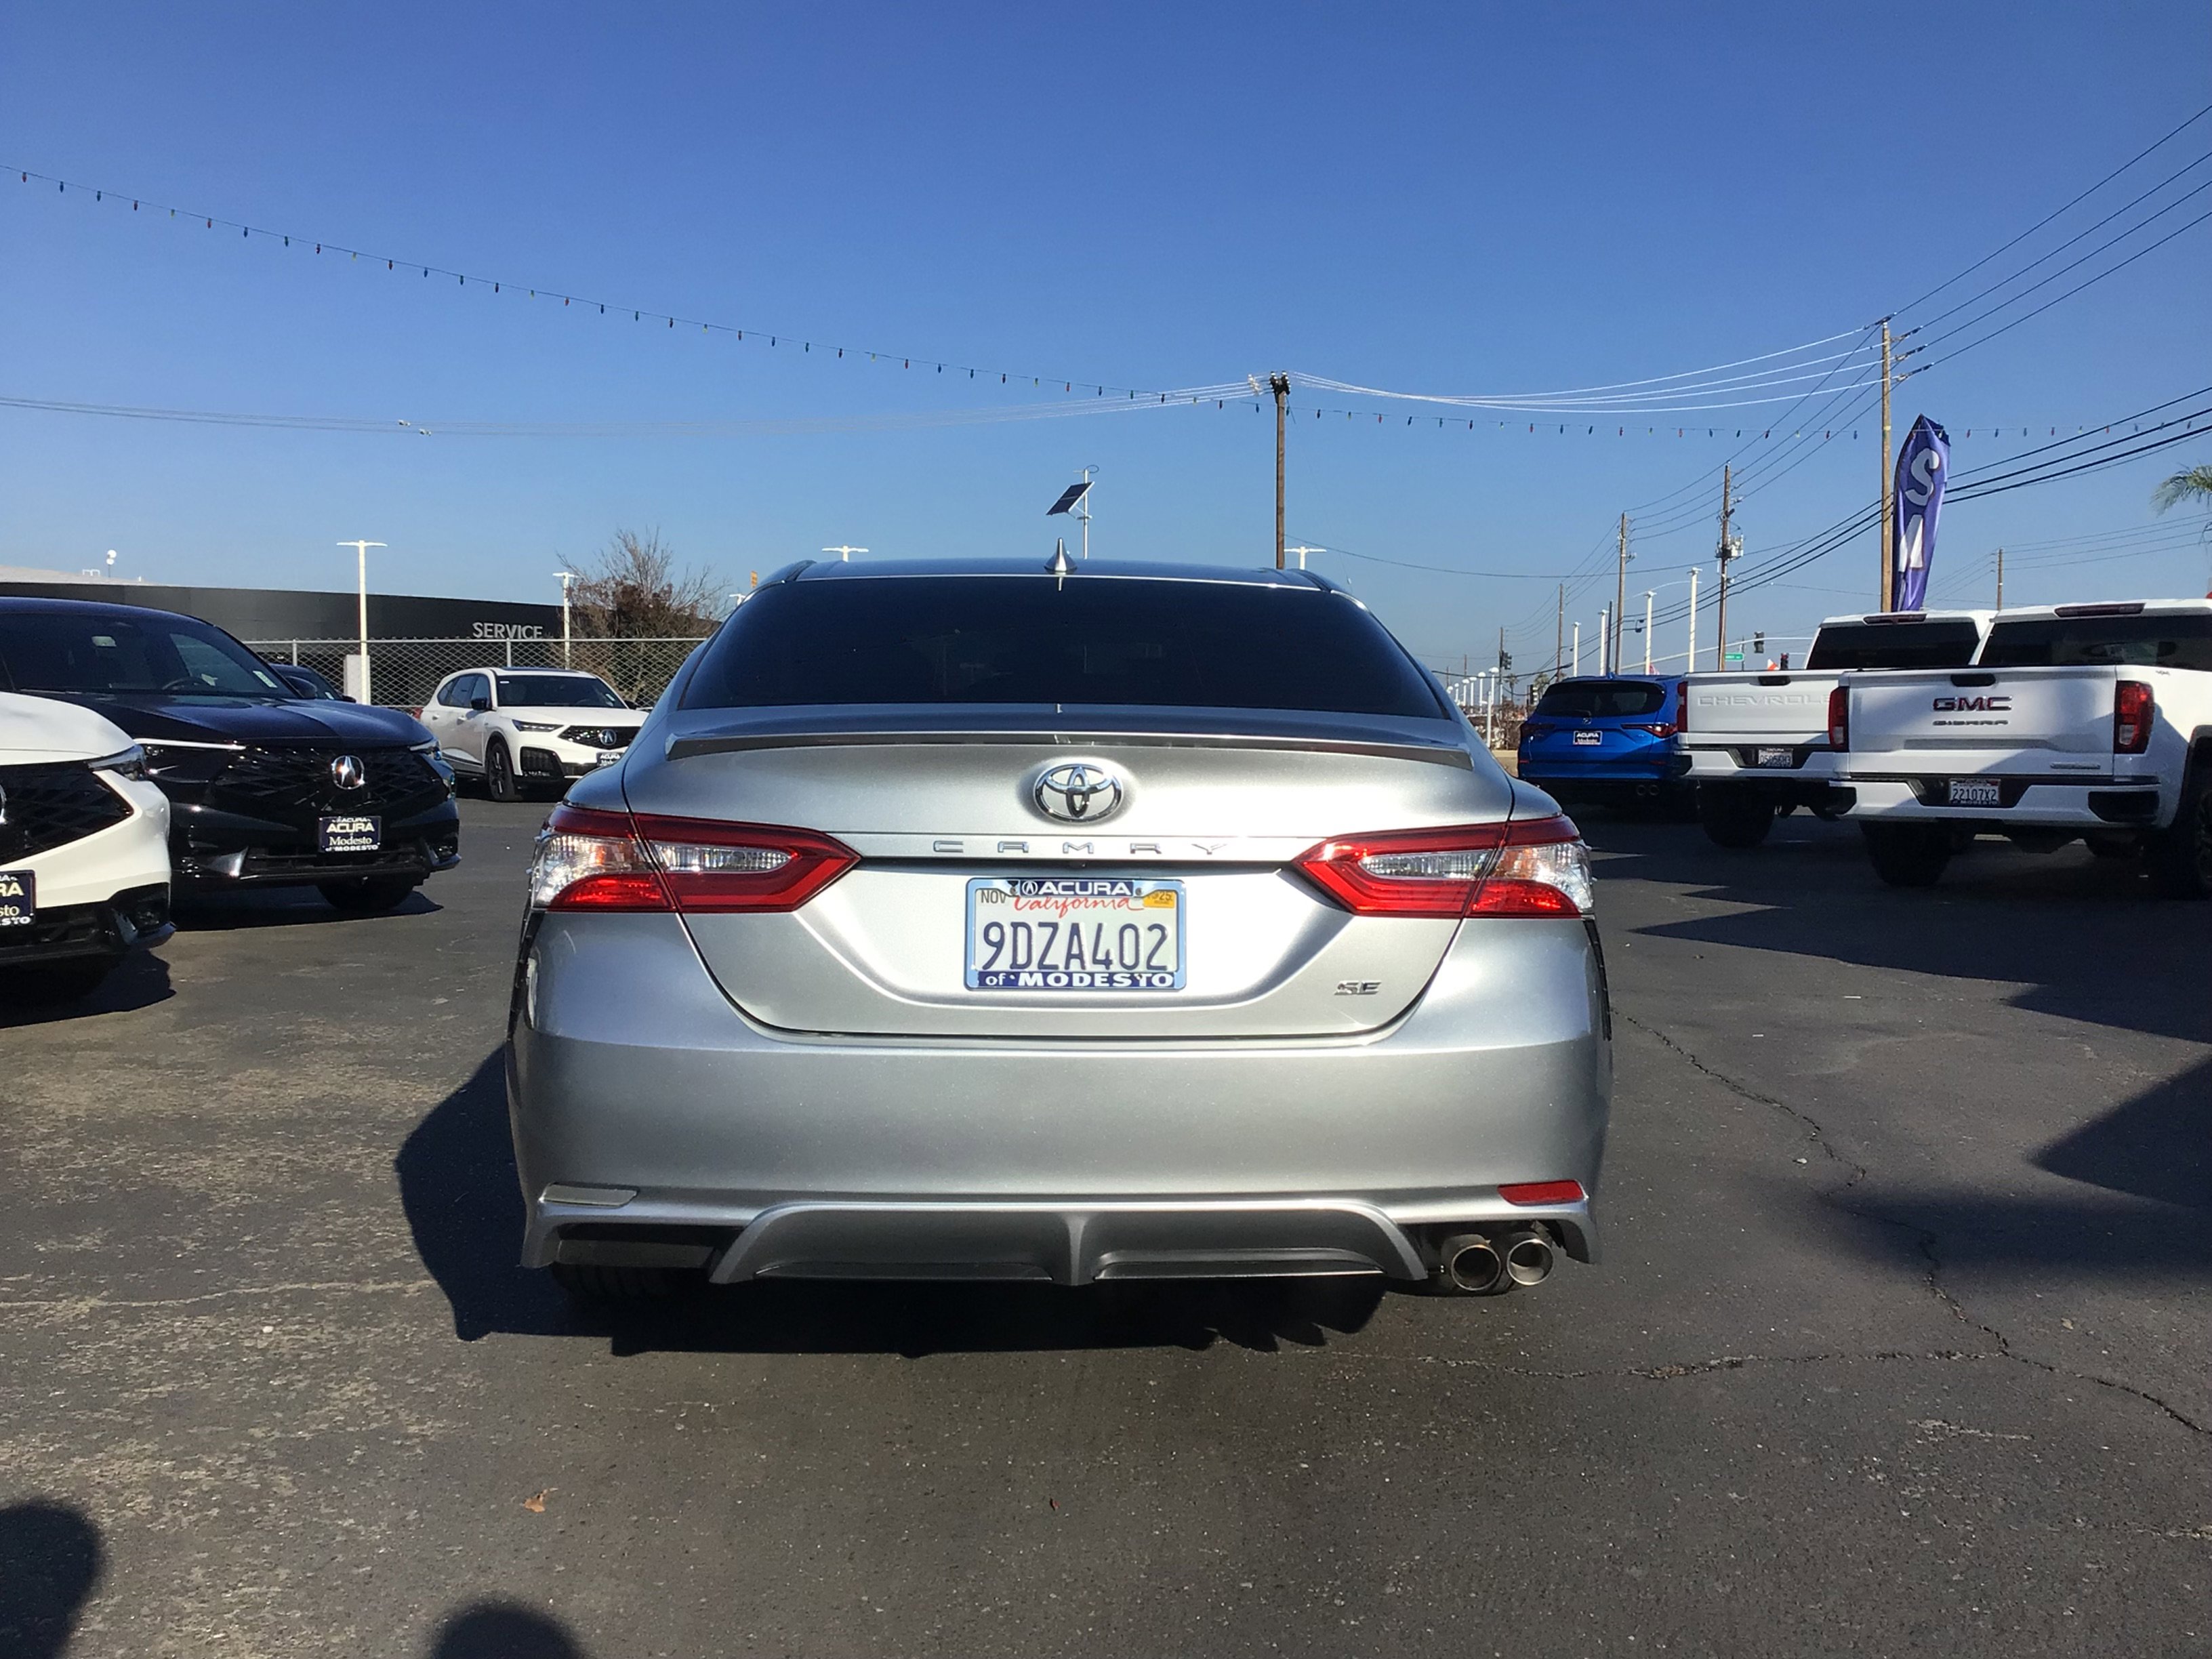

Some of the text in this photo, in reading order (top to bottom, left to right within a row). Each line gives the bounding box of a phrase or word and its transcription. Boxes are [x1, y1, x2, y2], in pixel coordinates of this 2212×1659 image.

[472, 622, 543, 639] SERVICE
[1698, 695, 1830, 706] CHEVROL
[1933, 697, 2011, 711] GMC
[1952, 789, 1996, 801] 22107X2
[326, 822, 375, 833] ACURA
[329, 836, 373, 846] Modesto
[933, 840, 1227, 855] CAMRY
[1039, 882, 1131, 895] ACURA
[981, 889, 1006, 903] NOV
[1014, 895, 1144, 919] California
[983, 921, 1168, 970] 9DZA402
[985, 972, 1173, 987] of MODESTO
[1334, 980, 1381, 996] SE
